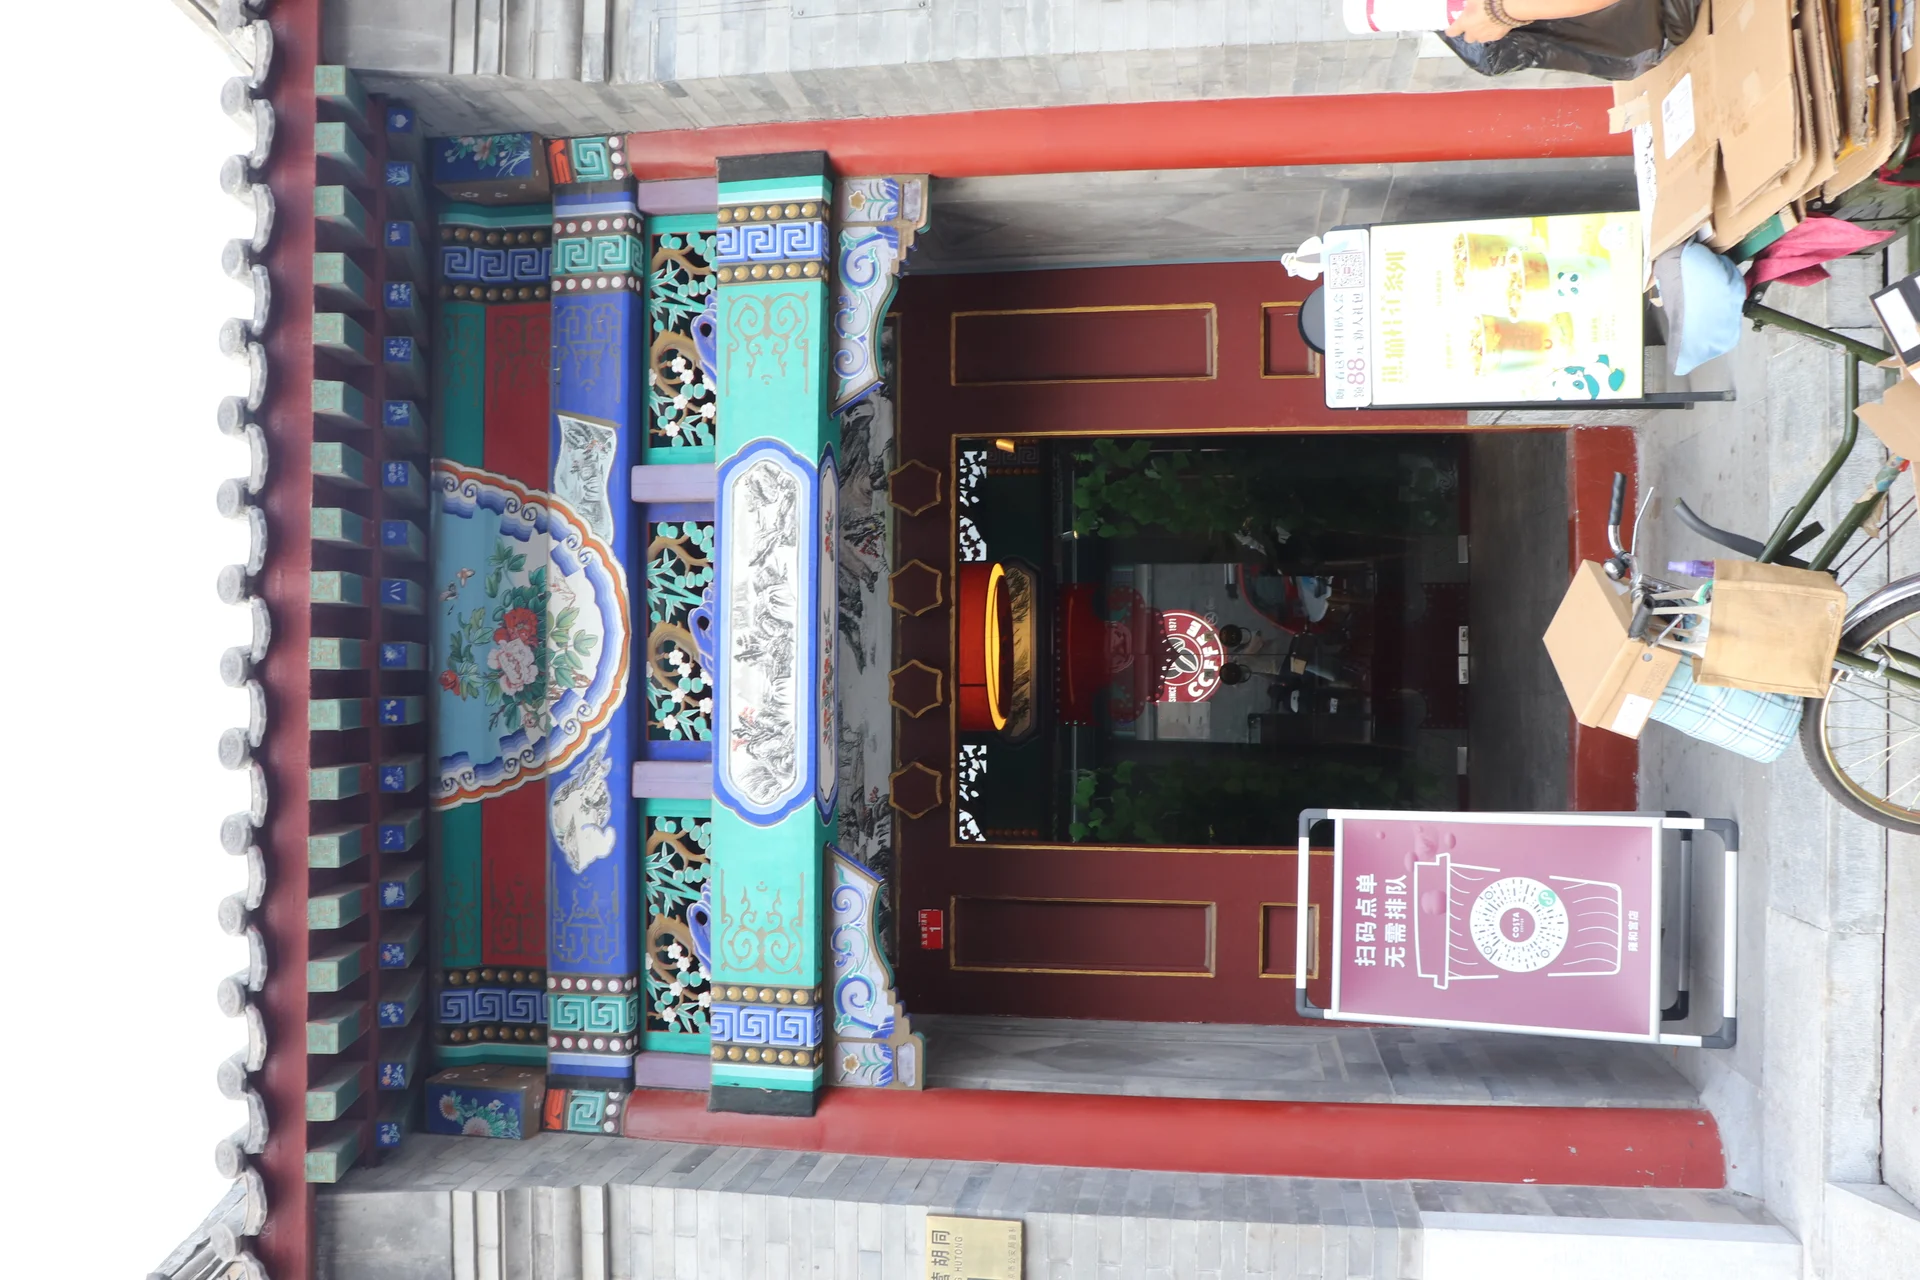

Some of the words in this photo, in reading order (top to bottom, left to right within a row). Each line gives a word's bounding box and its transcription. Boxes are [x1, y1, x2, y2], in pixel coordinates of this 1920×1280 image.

[1168, 618, 1177, 632] 1971
[1168, 686, 1177, 702] SINCE
[1354, 873, 1378, 966] 扫码点单
[1384, 874, 1408, 968] 无需排队
[1512, 912, 1520, 938] COSTA
[1628, 910, 1639, 952] 雍和宫店
[954, 1236, 963, 1272] HUTONG
